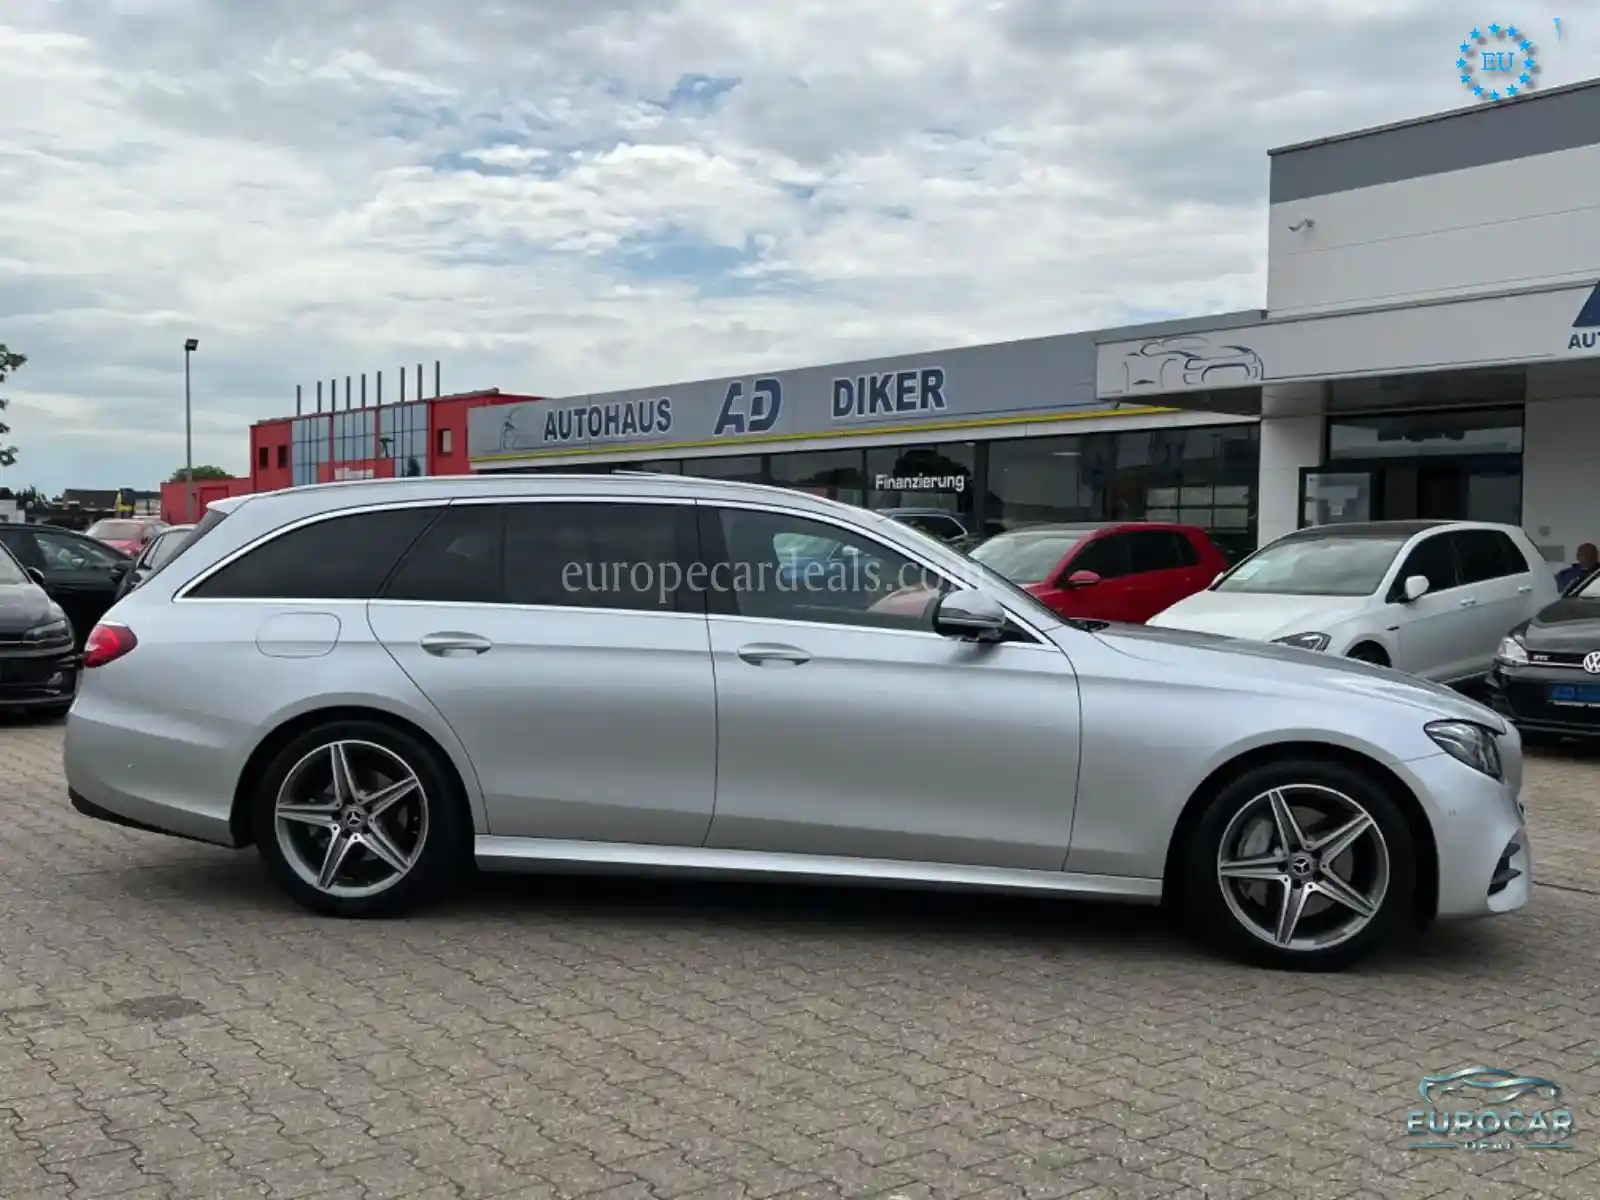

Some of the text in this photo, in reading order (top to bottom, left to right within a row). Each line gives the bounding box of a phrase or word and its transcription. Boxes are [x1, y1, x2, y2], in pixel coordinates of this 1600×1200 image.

[544, 367, 947, 442] AUTOHAUS AD DIKER
[875, 473, 965, 493] Finanzierung
